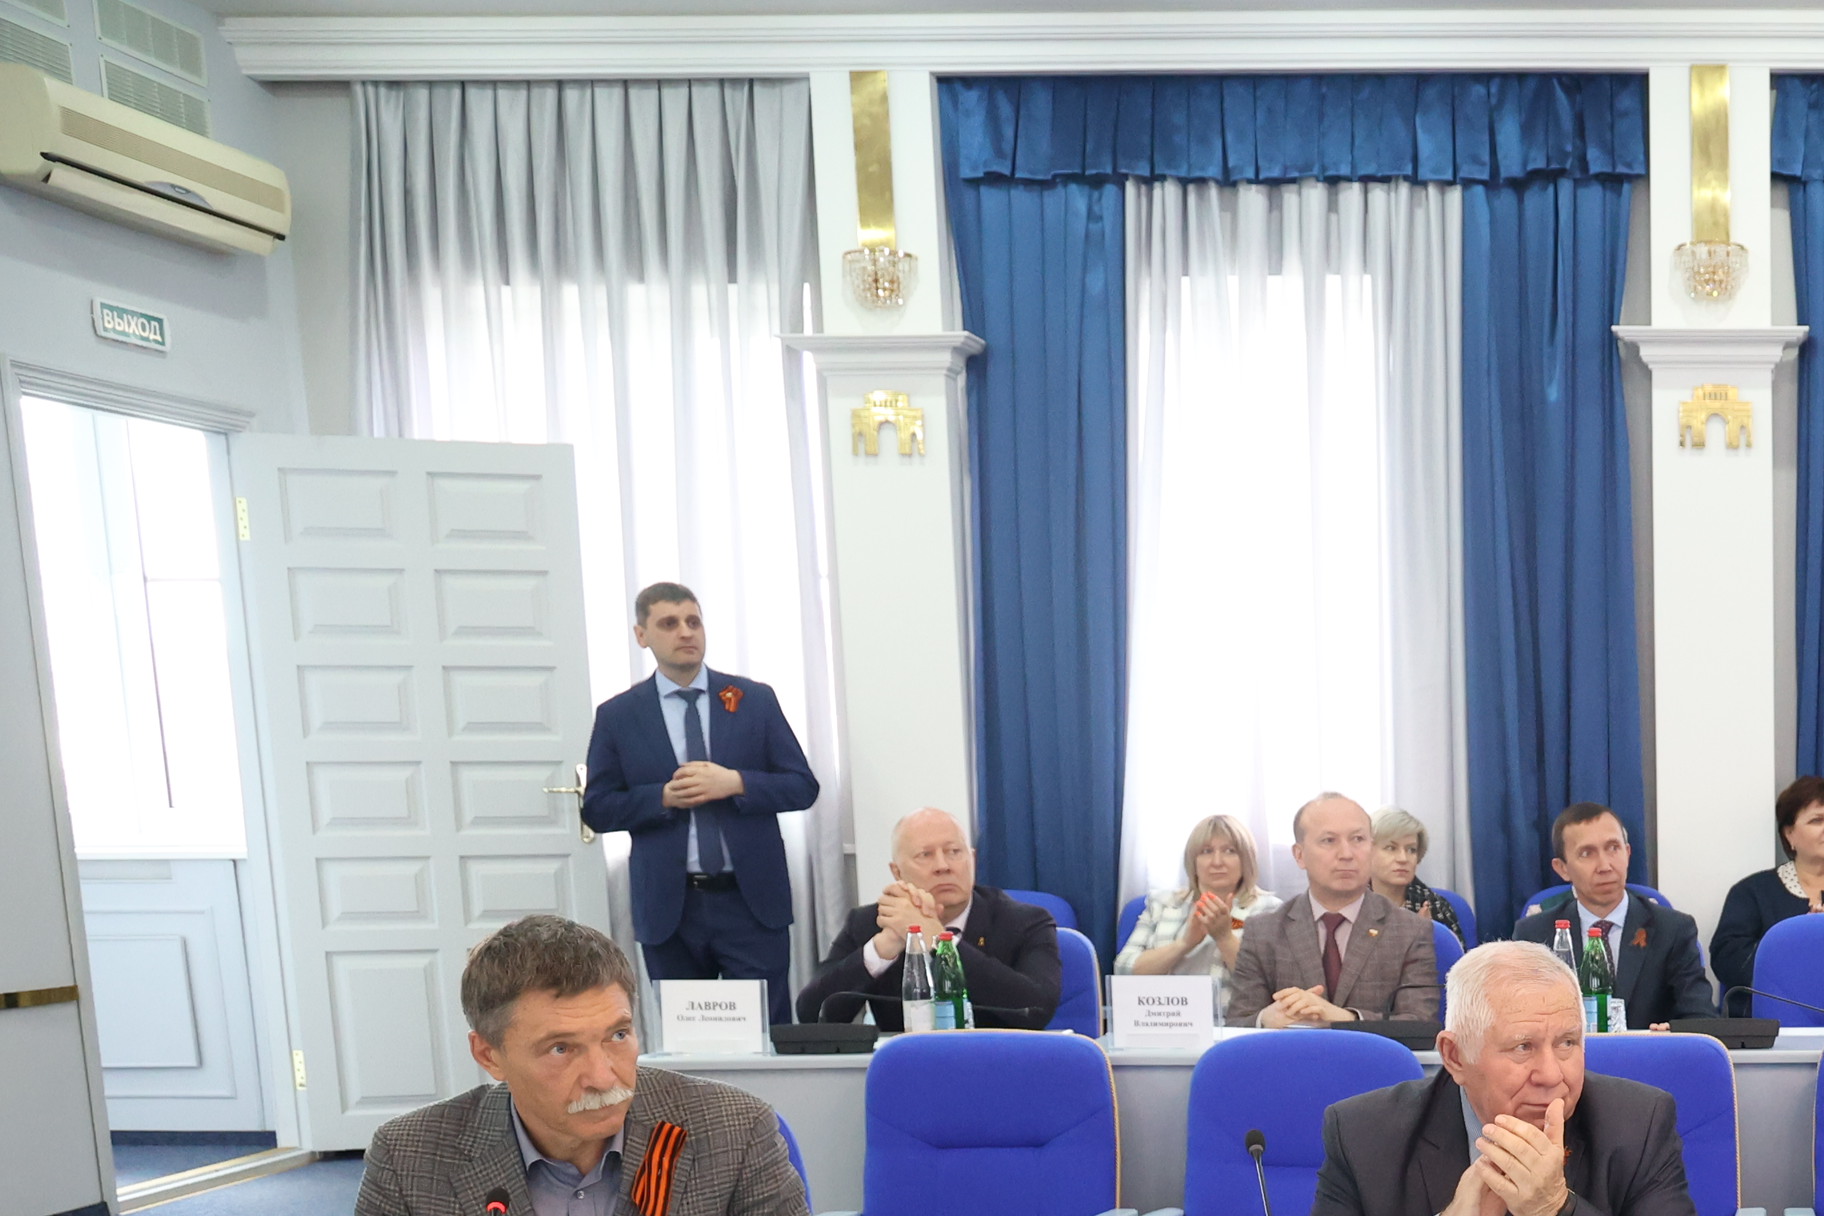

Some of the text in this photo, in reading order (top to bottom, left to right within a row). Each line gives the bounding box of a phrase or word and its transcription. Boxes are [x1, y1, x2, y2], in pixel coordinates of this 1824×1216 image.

[102, 308, 163, 342] ВЫХОД
[685, 1000, 737, 1011] ЛАВРОВ
[1137, 996, 1189, 1007] КОЗЛОВ
